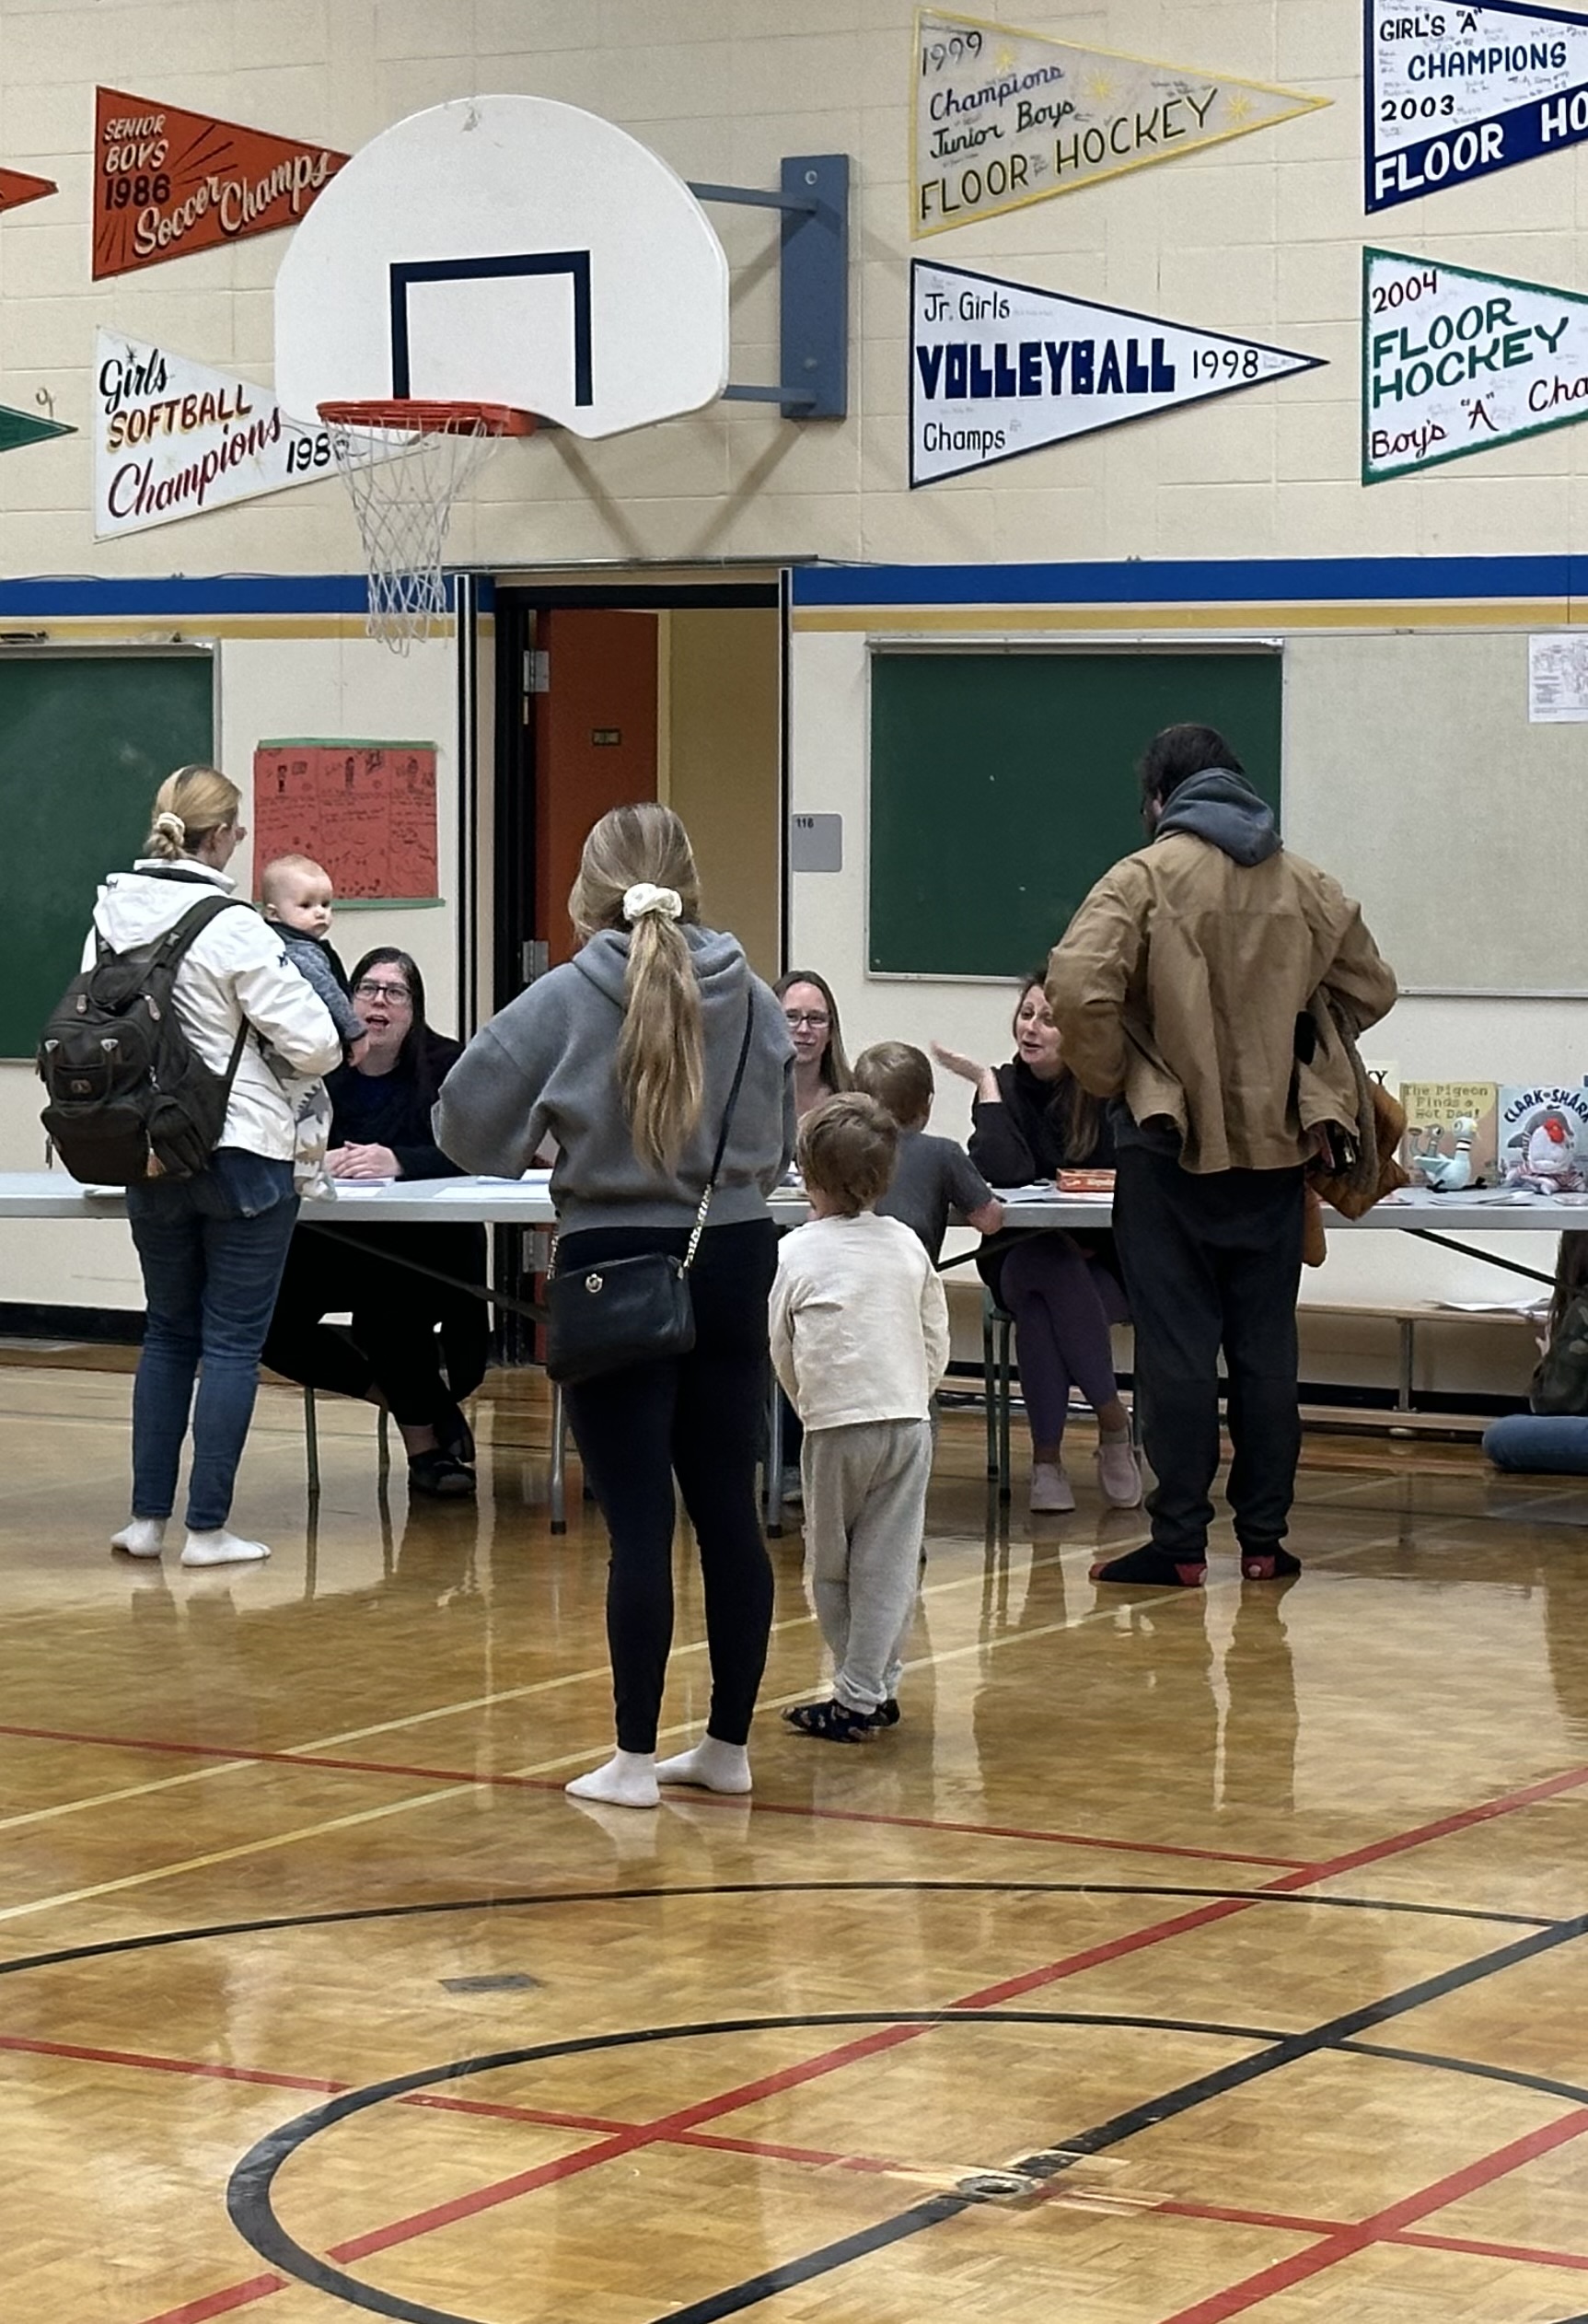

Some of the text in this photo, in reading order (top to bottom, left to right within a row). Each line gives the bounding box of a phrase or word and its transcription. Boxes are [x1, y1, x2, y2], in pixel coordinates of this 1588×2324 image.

[1381, 14, 1446, 41] GIRL'S
[921, 30, 983, 76] 1999
[1408, 41, 1567, 81] CHAMPIONS
[930, 63, 1065, 121] Champions
[1381, 94, 1455, 122] 2003
[104, 114, 166, 144] SENIOR
[930, 99, 1076, 158] Junior Boys
[1375, 90, 1588, 201] FLOOR HO
[104, 139, 169, 176] BOYS
[921, 87, 1218, 219] FLOOR HOCKEY
[105, 173, 171, 211] 1986
[133, 151, 337, 257] Soccer Champs
[924, 291, 1011, 322] Jr. Girls
[1373, 269, 1438, 314] 2004
[1373, 297, 1519, 368] FLOOR
[99, 348, 168, 415] Girls
[916, 337, 1259, 400] VOLLEYBALL 1998
[1373, 316, 1570, 409] HOCKEY
[107, 383, 253, 453] SOFTBALL
[1372, 418, 1448, 459] Boy's
[1528, 375, 1588, 413] Cha
[108, 406, 282, 518] Champions
[922, 422, 1006, 459] Champs
[1404, 1085, 1488, 1097] The Pigeon
[1417, 1097, 1460, 1108] Finds
[1503, 1089, 1544, 1122] CLARK
[1415, 1109, 1440, 1119] Hot
